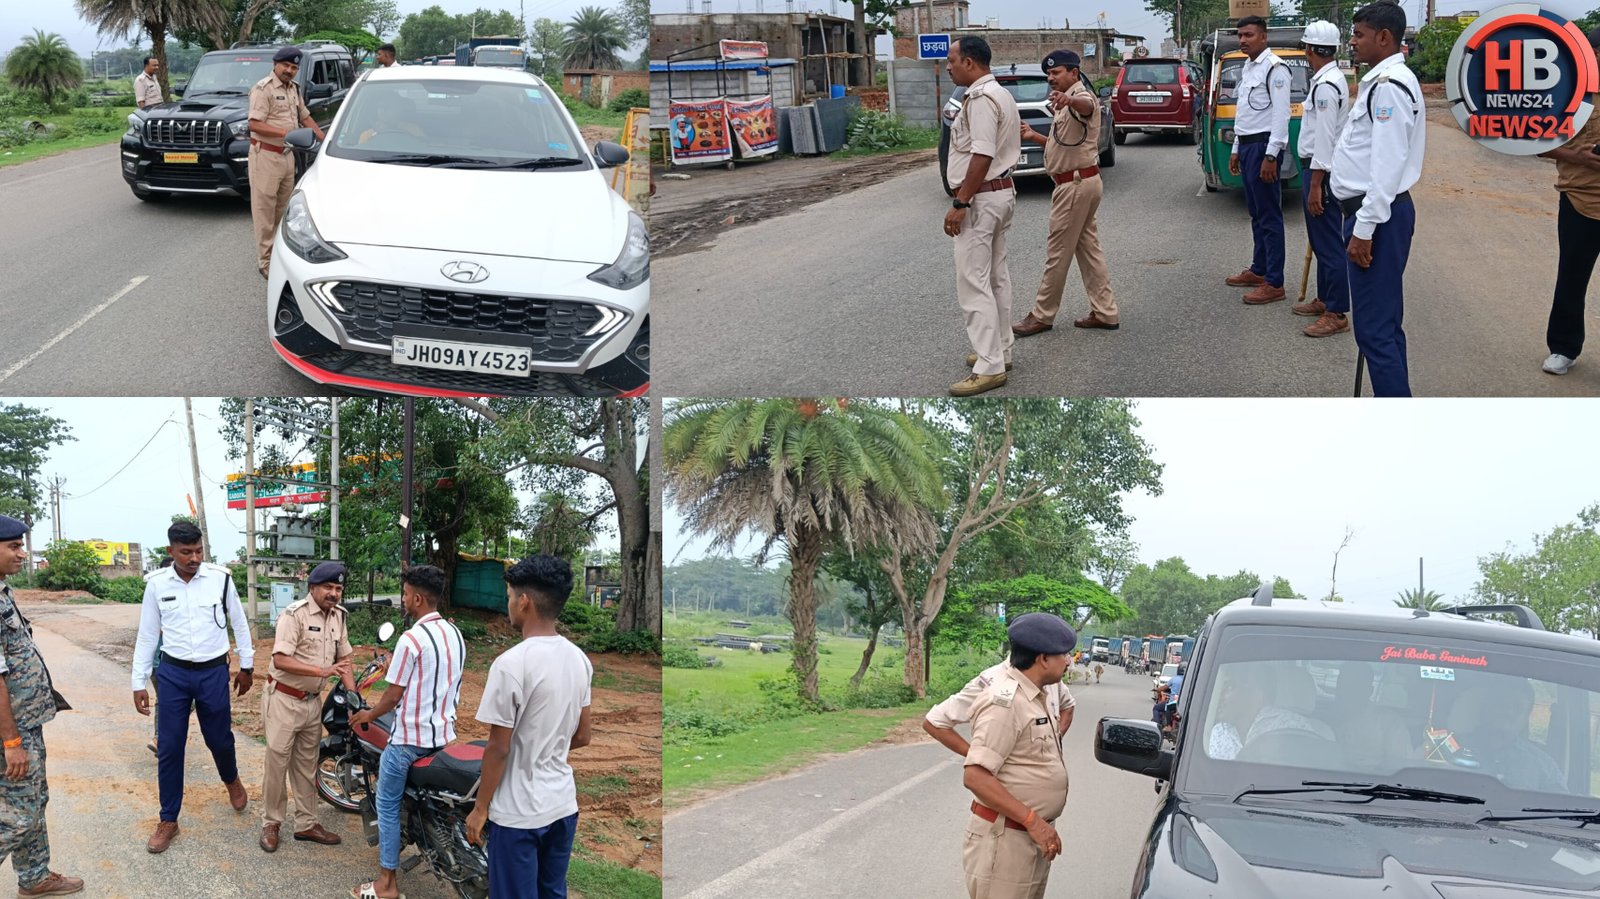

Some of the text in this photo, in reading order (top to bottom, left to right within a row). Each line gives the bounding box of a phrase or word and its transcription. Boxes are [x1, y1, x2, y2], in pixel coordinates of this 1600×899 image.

[922, 41, 948, 53] छड़वा
[407, 344, 529, 372] JH09AY4523
[1380, 646, 1402, 661] Jai
[1404, 647, 1438, 661] Baba
